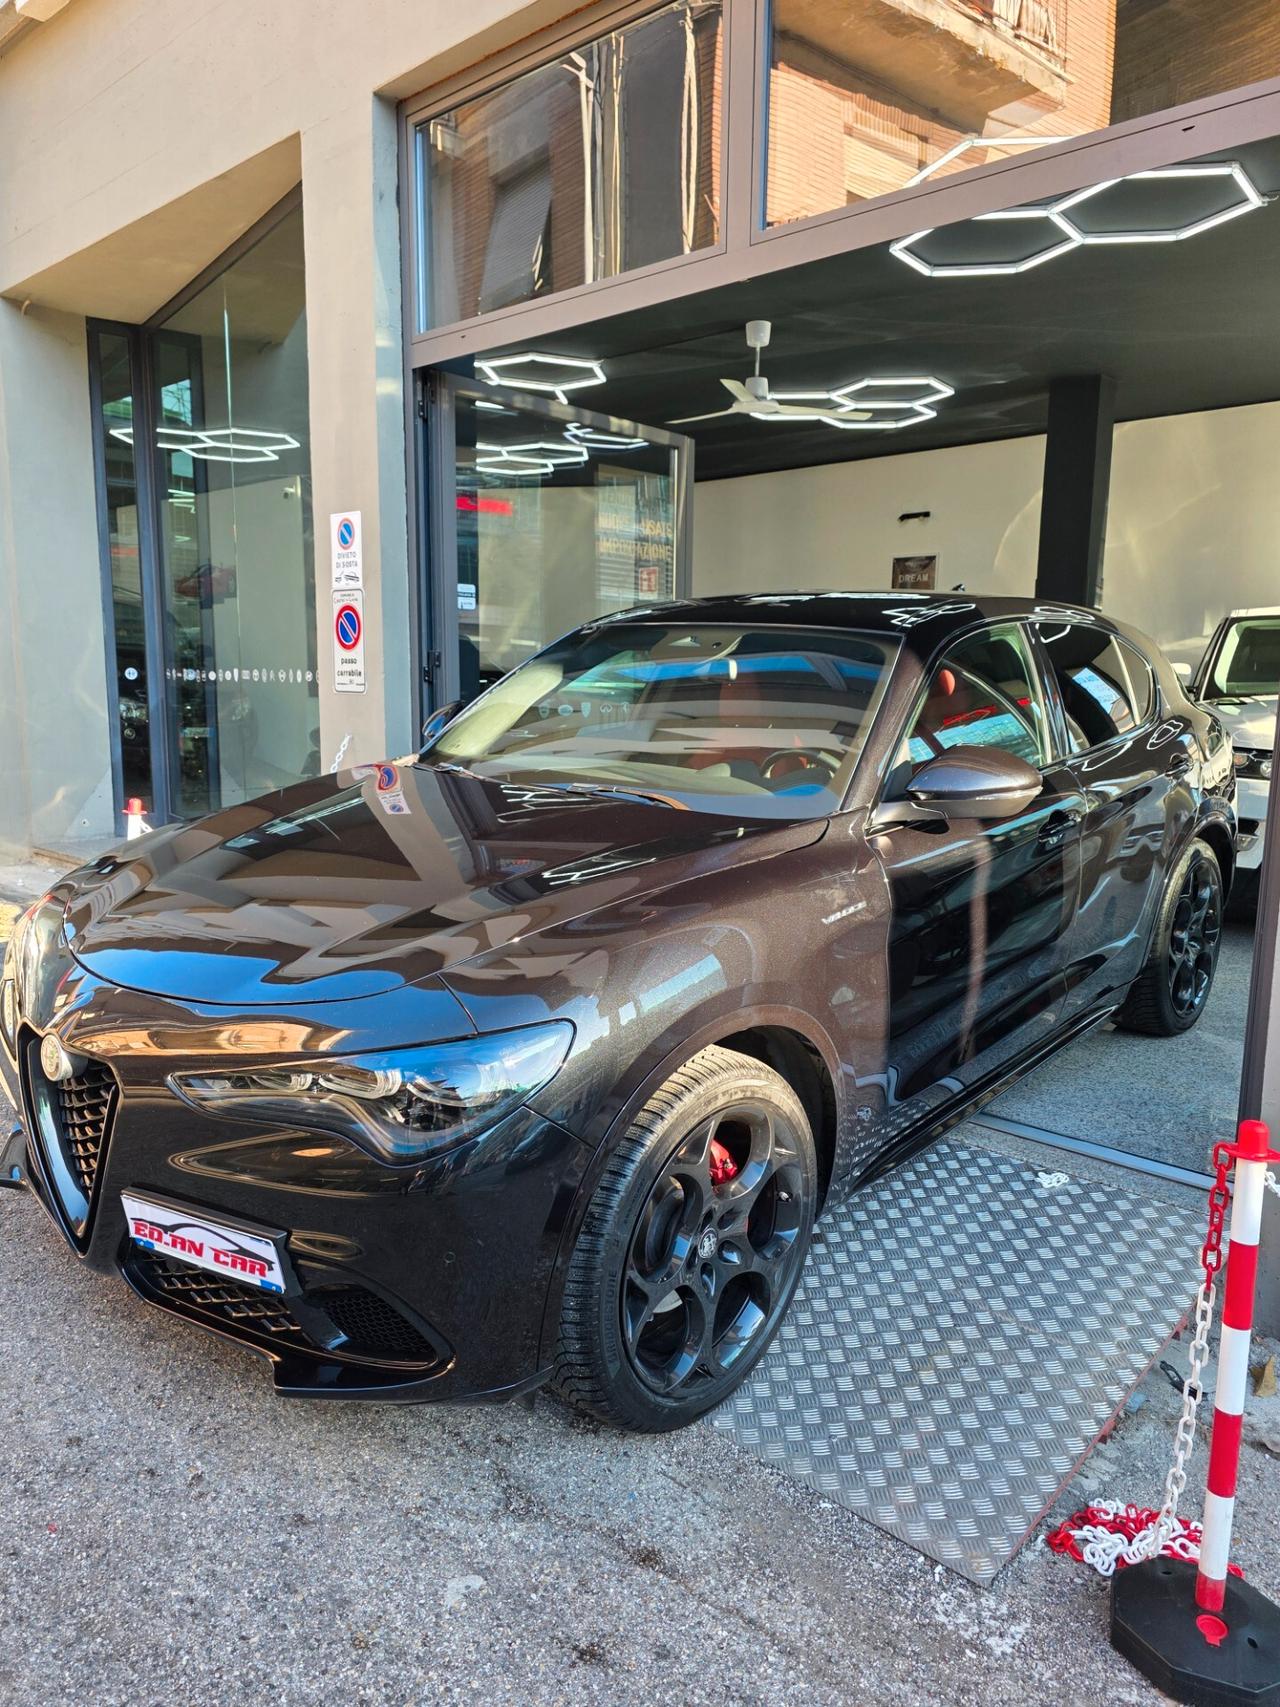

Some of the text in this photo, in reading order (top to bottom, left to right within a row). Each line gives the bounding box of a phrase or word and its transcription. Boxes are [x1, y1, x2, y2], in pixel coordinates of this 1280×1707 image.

[337, 551, 357, 559] DIVIETO
[342, 560, 358, 568] SOSTA
[898, 573, 929, 584] DREAM
[341, 657, 358, 665] passo
[337, 669, 362, 677] carrabile
[133, 1220, 268, 1278] ED.AN CAR
